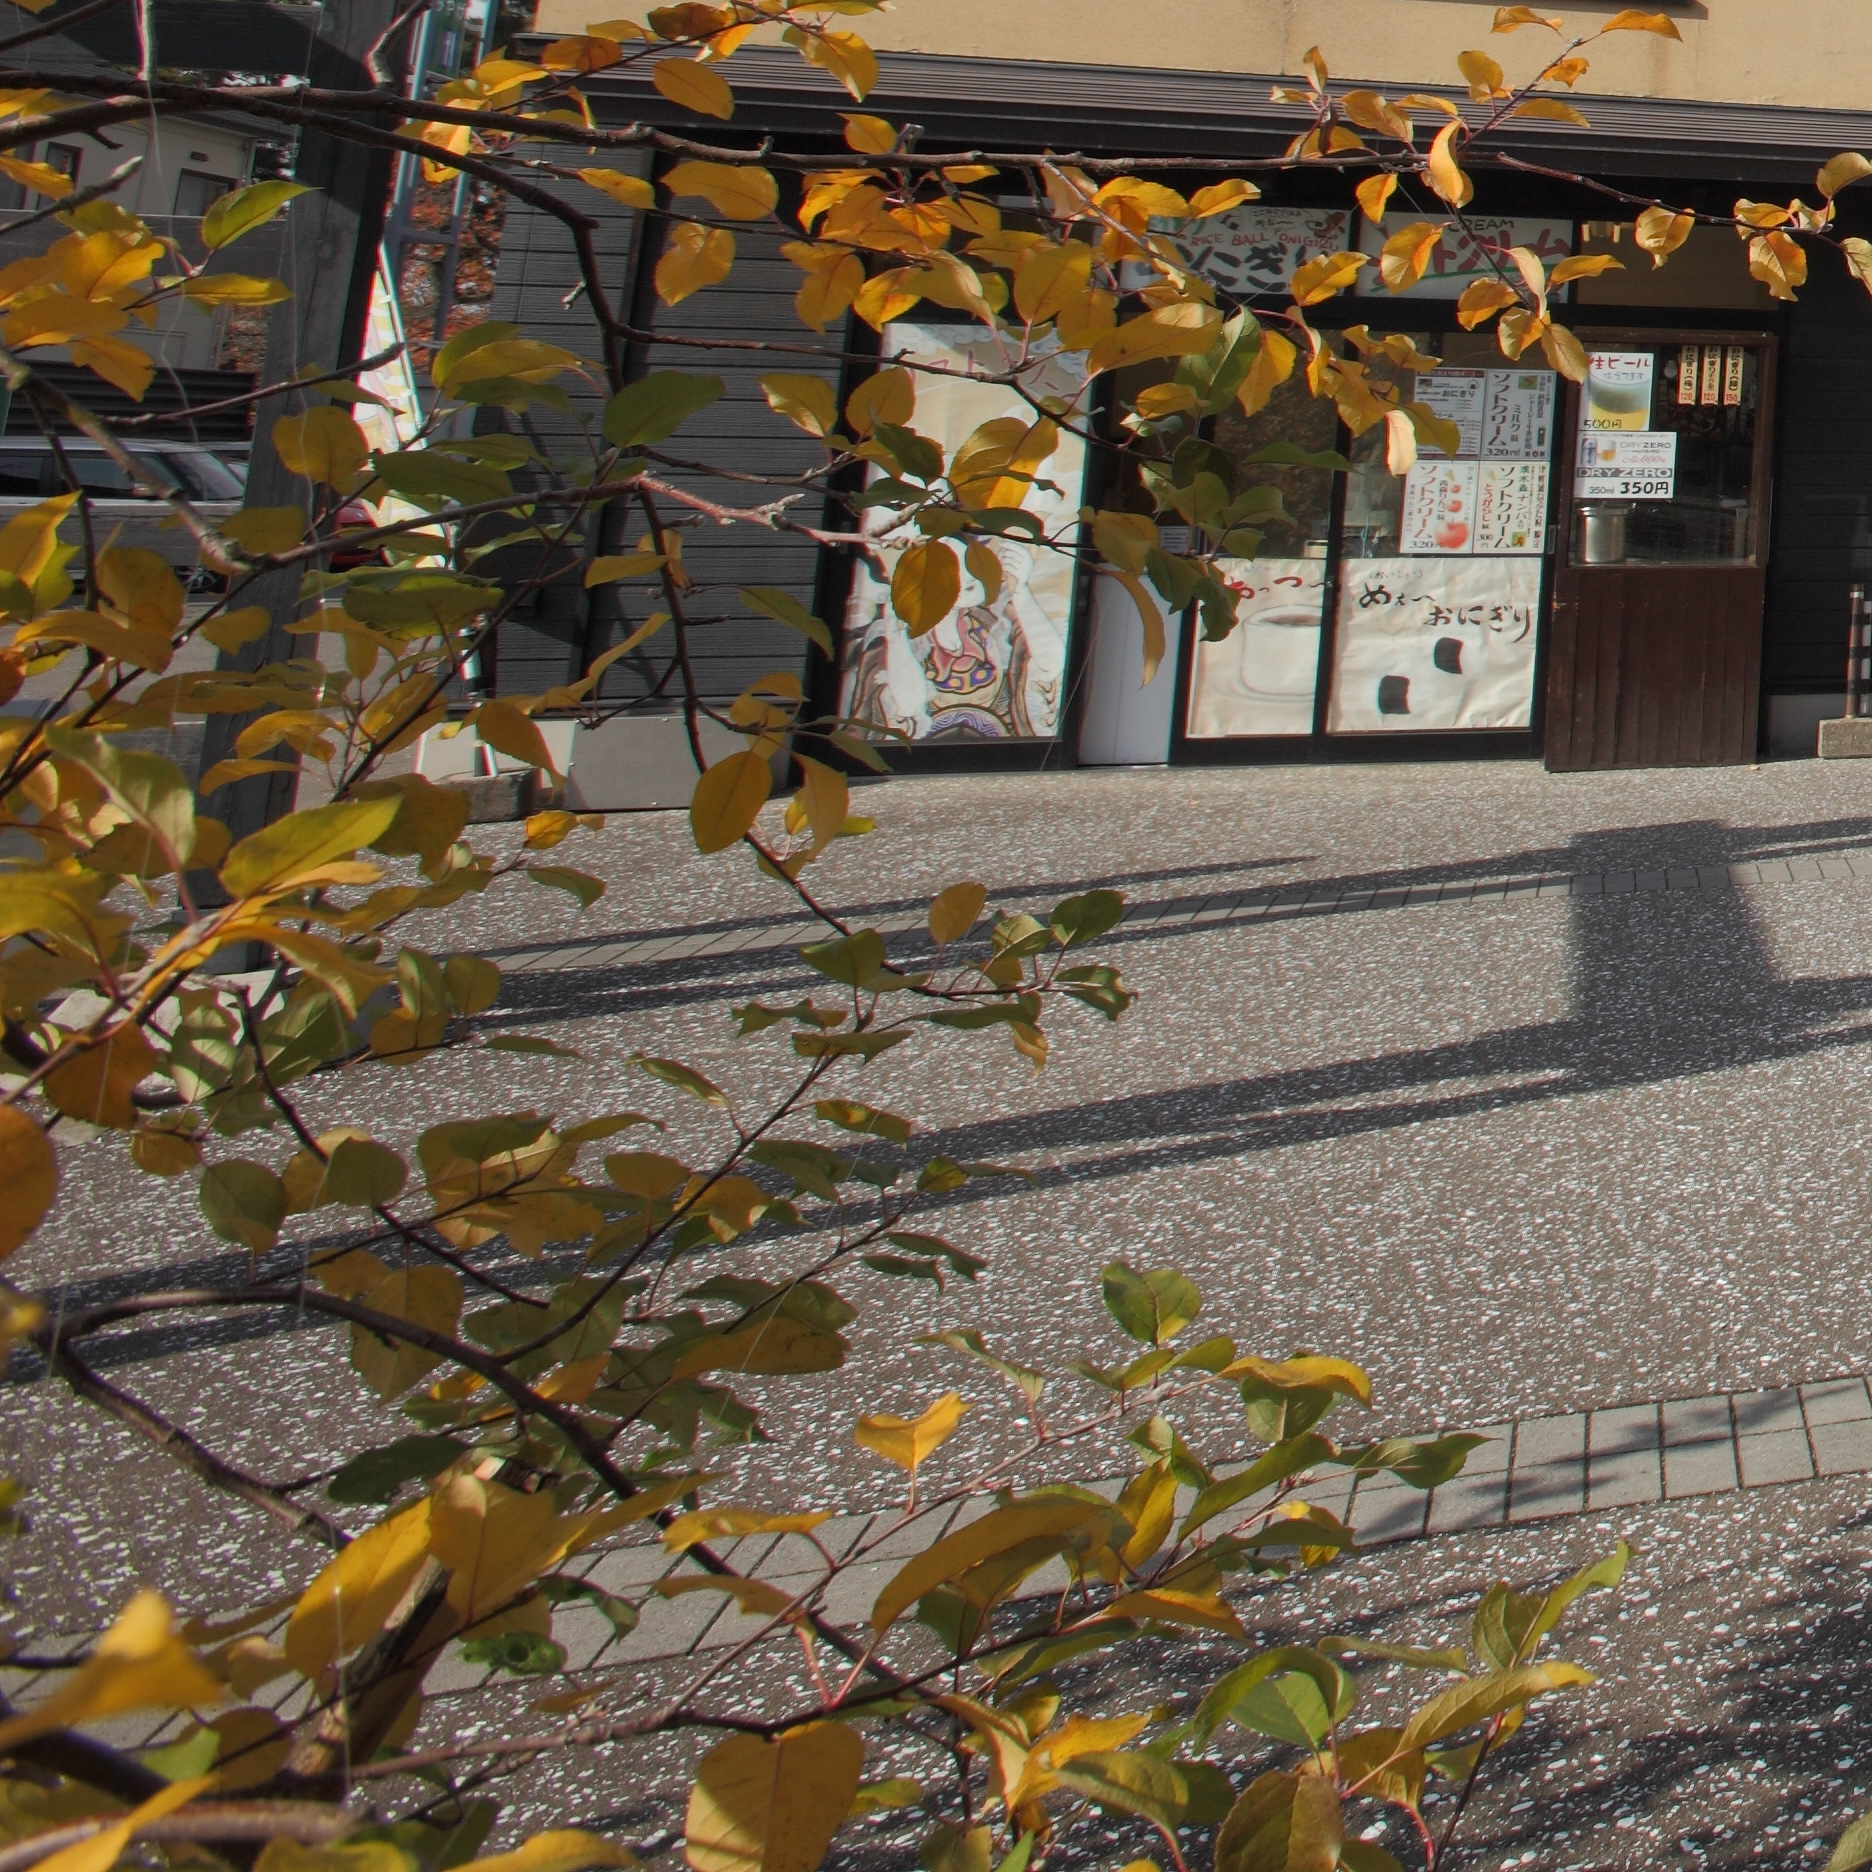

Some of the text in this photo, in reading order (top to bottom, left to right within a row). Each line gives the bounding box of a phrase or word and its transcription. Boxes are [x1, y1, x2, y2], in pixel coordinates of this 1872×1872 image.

[1231, 232, 1269, 245] BALL
[1588, 355, 1651, 369] 生ビール
[1487, 373, 1511, 446] ソフトクリーム
[1579, 468, 1672, 477] DRY ZERO
[1620, 481, 1669, 495] 350円
[1414, 465, 1438, 539] ソフトクリーム
[1494, 466, 1515, 549] ソフトクリーム
[1423, 604, 1532, 644] おにぎり
